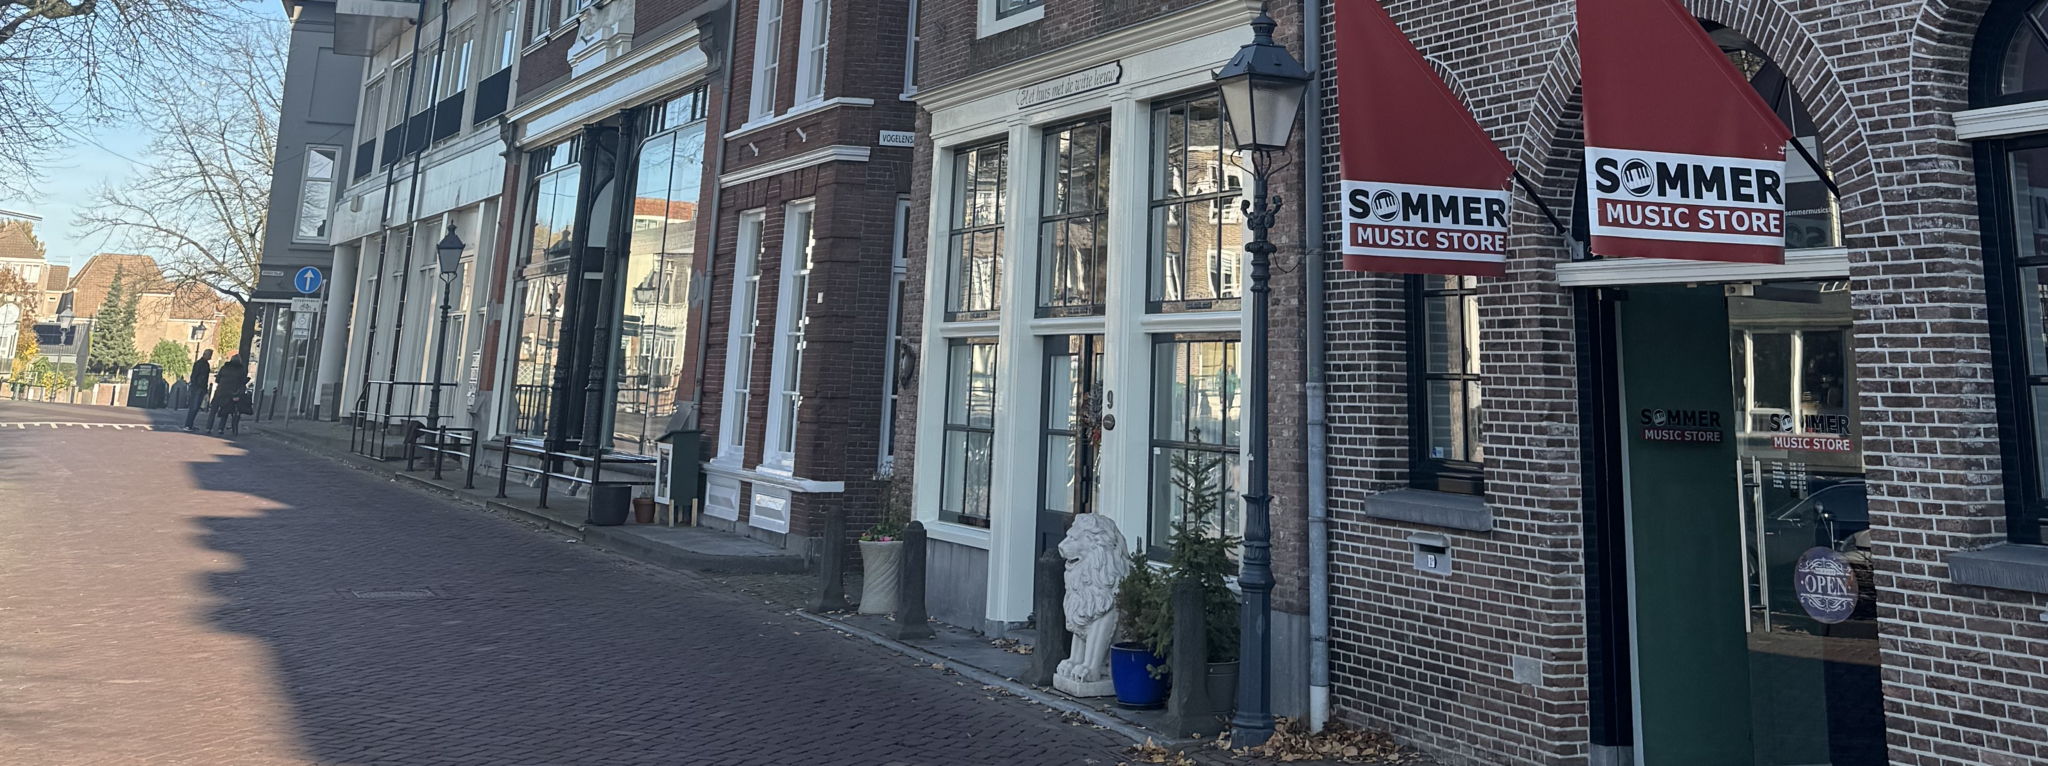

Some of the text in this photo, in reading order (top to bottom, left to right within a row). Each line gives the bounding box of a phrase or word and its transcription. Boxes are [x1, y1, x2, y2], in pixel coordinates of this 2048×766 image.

[1020, 69, 1116, 105] Het huis met de witte leeuw
[882, 134, 915, 144] VOGELENS
[1595, 157, 1783, 205] SOMMER
[1348, 189, 1508, 228] SOMMER
[1606, 202, 1781, 233] MUSIC STORE
[1357, 226, 1505, 252] MUSIC STORE
[1107, 390, 1113, 409] 9
[1641, 408, 1722, 428] SOMMER
[1645, 430, 1721, 442] MUSIC STORE
[1774, 436, 1850, 451] MUSIC STORE
[1804, 574, 1848, 596] OPEN
